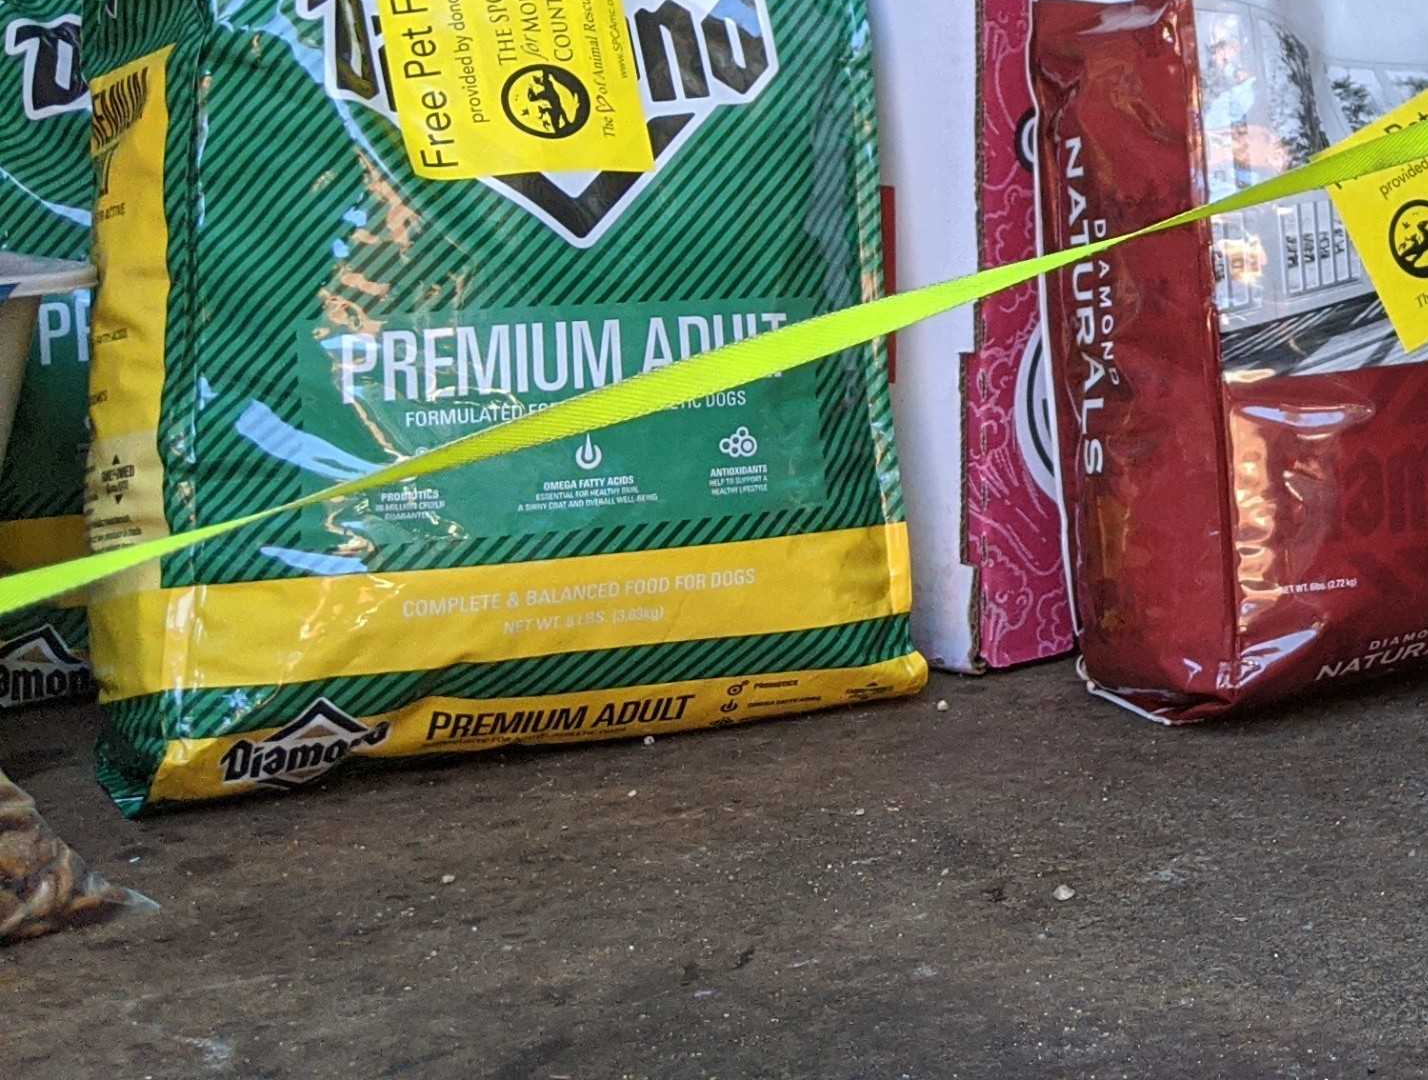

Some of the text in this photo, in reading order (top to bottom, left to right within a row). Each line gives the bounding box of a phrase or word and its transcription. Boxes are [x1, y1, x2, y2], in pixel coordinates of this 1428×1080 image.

[402, 25, 442, 79] Pet
[453, 35, 474, 55] by
[496, 27, 517, 66] THE
[520, 35, 549, 62] for
[584, 34, 605, 78] Animal
[454, 56, 490, 123] provided
[596, 78, 611, 96] of
[420, 90, 459, 168] Free
[602, 113, 616, 138] The
[1093, 218, 1121, 387] DAMOND
[340, 317, 621, 405] PREMIUM
[405, 402, 524, 428] FORMULATED
[705, 389, 747, 408] DOGS
[543, 475, 634, 491] OMEGA FATTY ACIDS
[710, 463, 768, 478] ANTIOXIDANTS
[381, 488, 440, 502] PROBIOTICS
[517, 503, 524, 512] A
[548, 499, 567, 511] COAT
[567, 498, 585, 509] AND
[585, 494, 616, 507] OVERALL
[535, 491, 574, 502] ESSENTIAL
[575, 489, 589, 499] FOR
[590, 486, 620, 497] HEALTHY
[402, 567, 756, 619] COMPLETE & BALANCED FOOD FOR DOGS
[503, 618, 532, 635] NET
[426, 705, 589, 742] PREMIUM
[592, 694, 695, 730] ADULT
